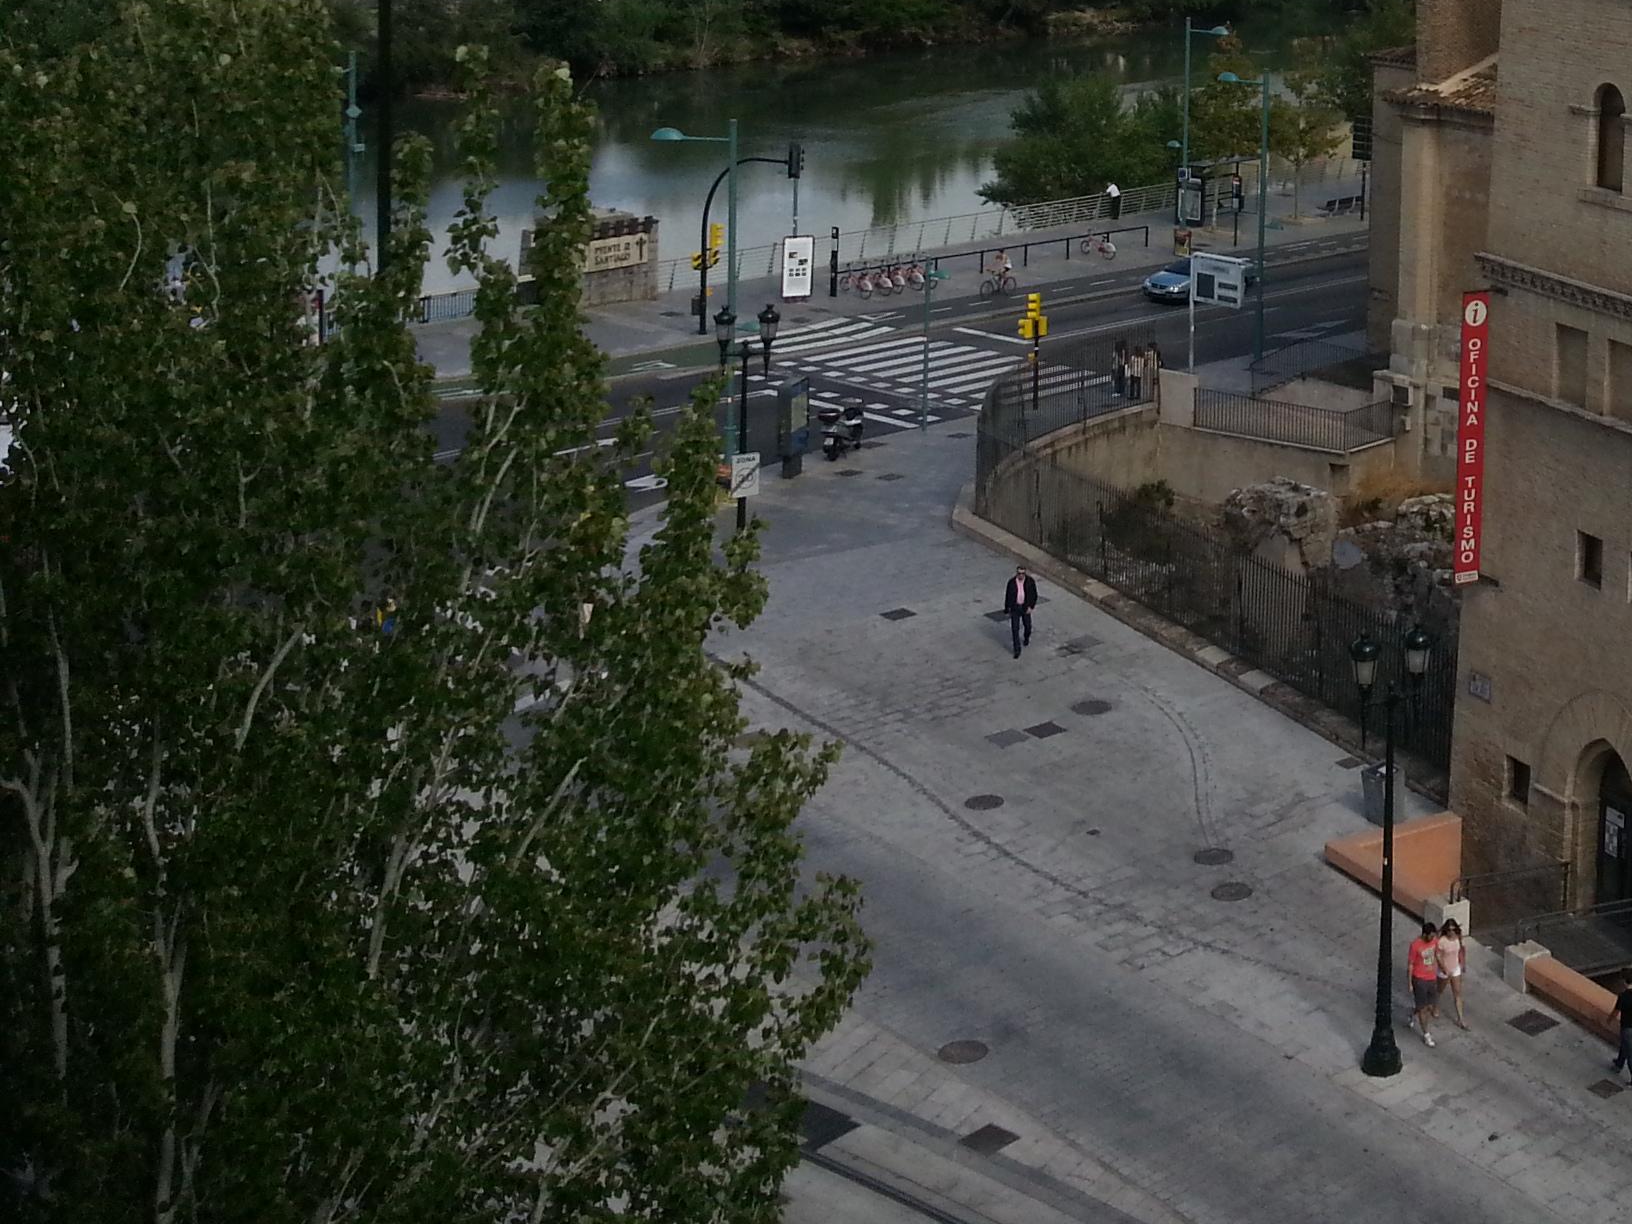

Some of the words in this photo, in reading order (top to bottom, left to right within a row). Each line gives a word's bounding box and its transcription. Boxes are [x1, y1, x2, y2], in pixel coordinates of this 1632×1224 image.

[595, 253, 630, 265] SANTIAGO
[1466, 338, 1482, 426] OFICINA
[736, 456, 756, 464] ZONA
[1465, 439, 1477, 464] DE
[1460, 476, 1475, 563] TURISMO
